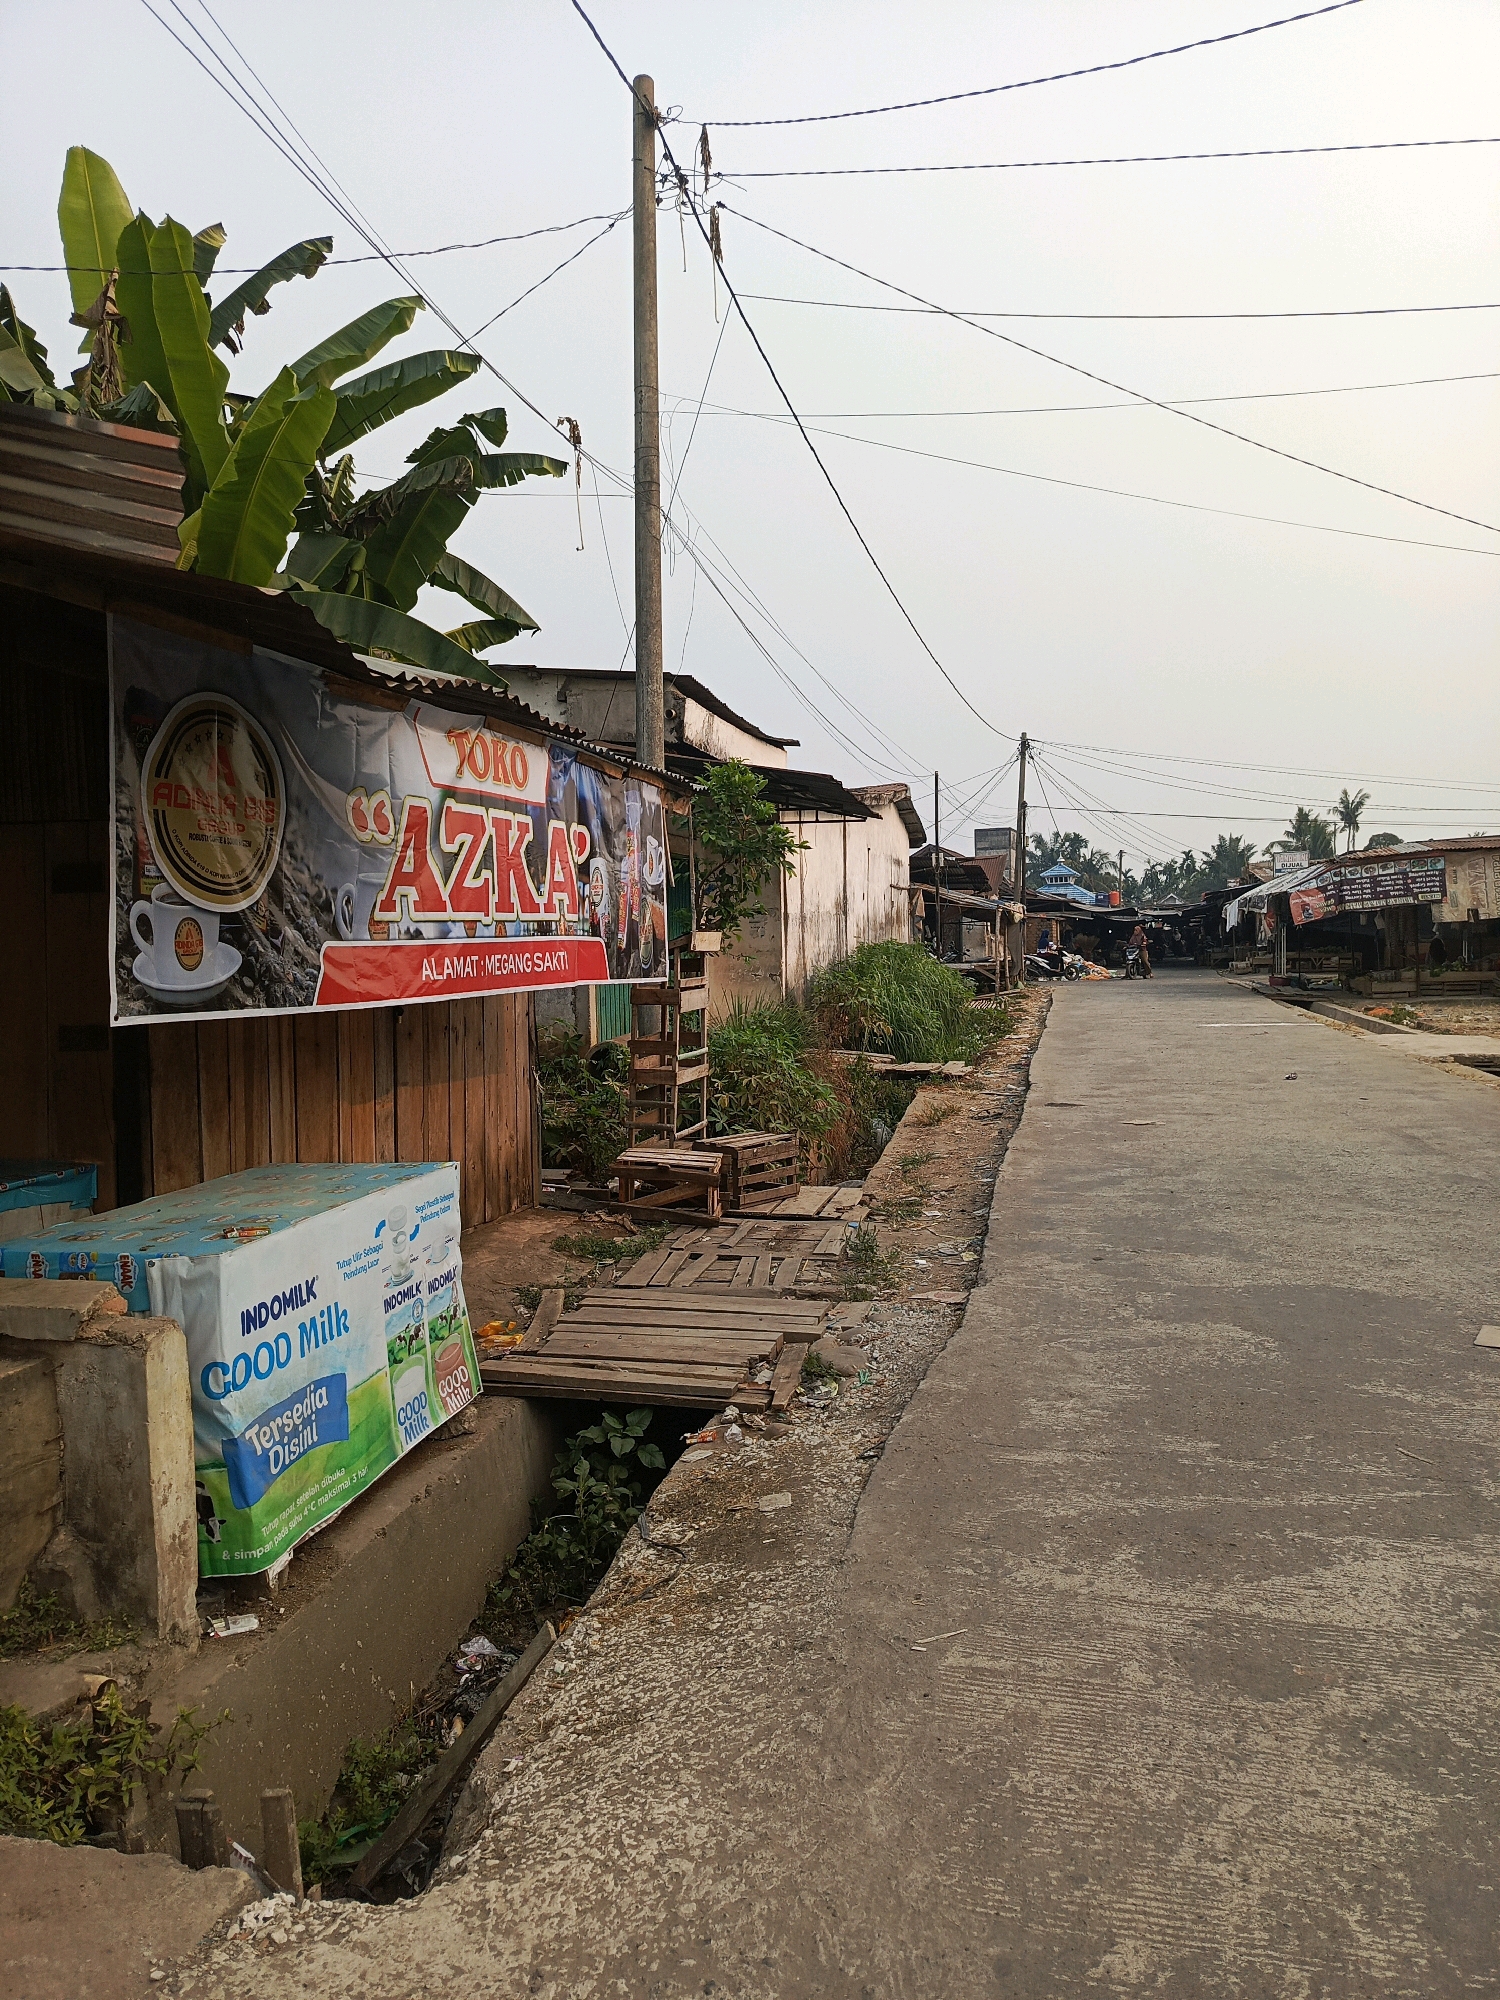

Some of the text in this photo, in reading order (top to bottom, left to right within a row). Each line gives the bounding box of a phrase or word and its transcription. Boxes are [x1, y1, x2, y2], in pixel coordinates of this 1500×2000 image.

[446, 727, 529, 790] TOKO
[422, 956, 479, 981] ALAMAT
[485, 953, 532, 976] MEGANG
[534, 951, 569, 972] SAKTI
[31, 1253, 44, 1279] ENAA
[119, 1254, 133, 1291] ENAAK
[427, 1265, 458, 1296] INDOMILK
[240, 1276, 317, 1337] INDOMILK
[384, 1280, 422, 1314] INDOMILK
[201, 1301, 350, 1400] GOOD Milk
[438, 1365, 469, 1398] GOOD
[398, 1391, 428, 1427] GOOD
[445, 1385, 471, 1415] Milk
[245, 1384, 329, 1456] Tersedia
[404, 1413, 430, 1445] Milk
[268, 1416, 319, 1475] Disini
[222, 1550, 231, 1560] &
[234, 1541, 274, 1560] simpan
[273, 1526, 289, 1546] pada
[288, 1513, 303, 1533] suhu
[317, 1480, 351, 1507] maksimal
[352, 1473, 357, 1483] 3
[261, 1467, 346, 1538] Tutup rapat setelah dibuka
